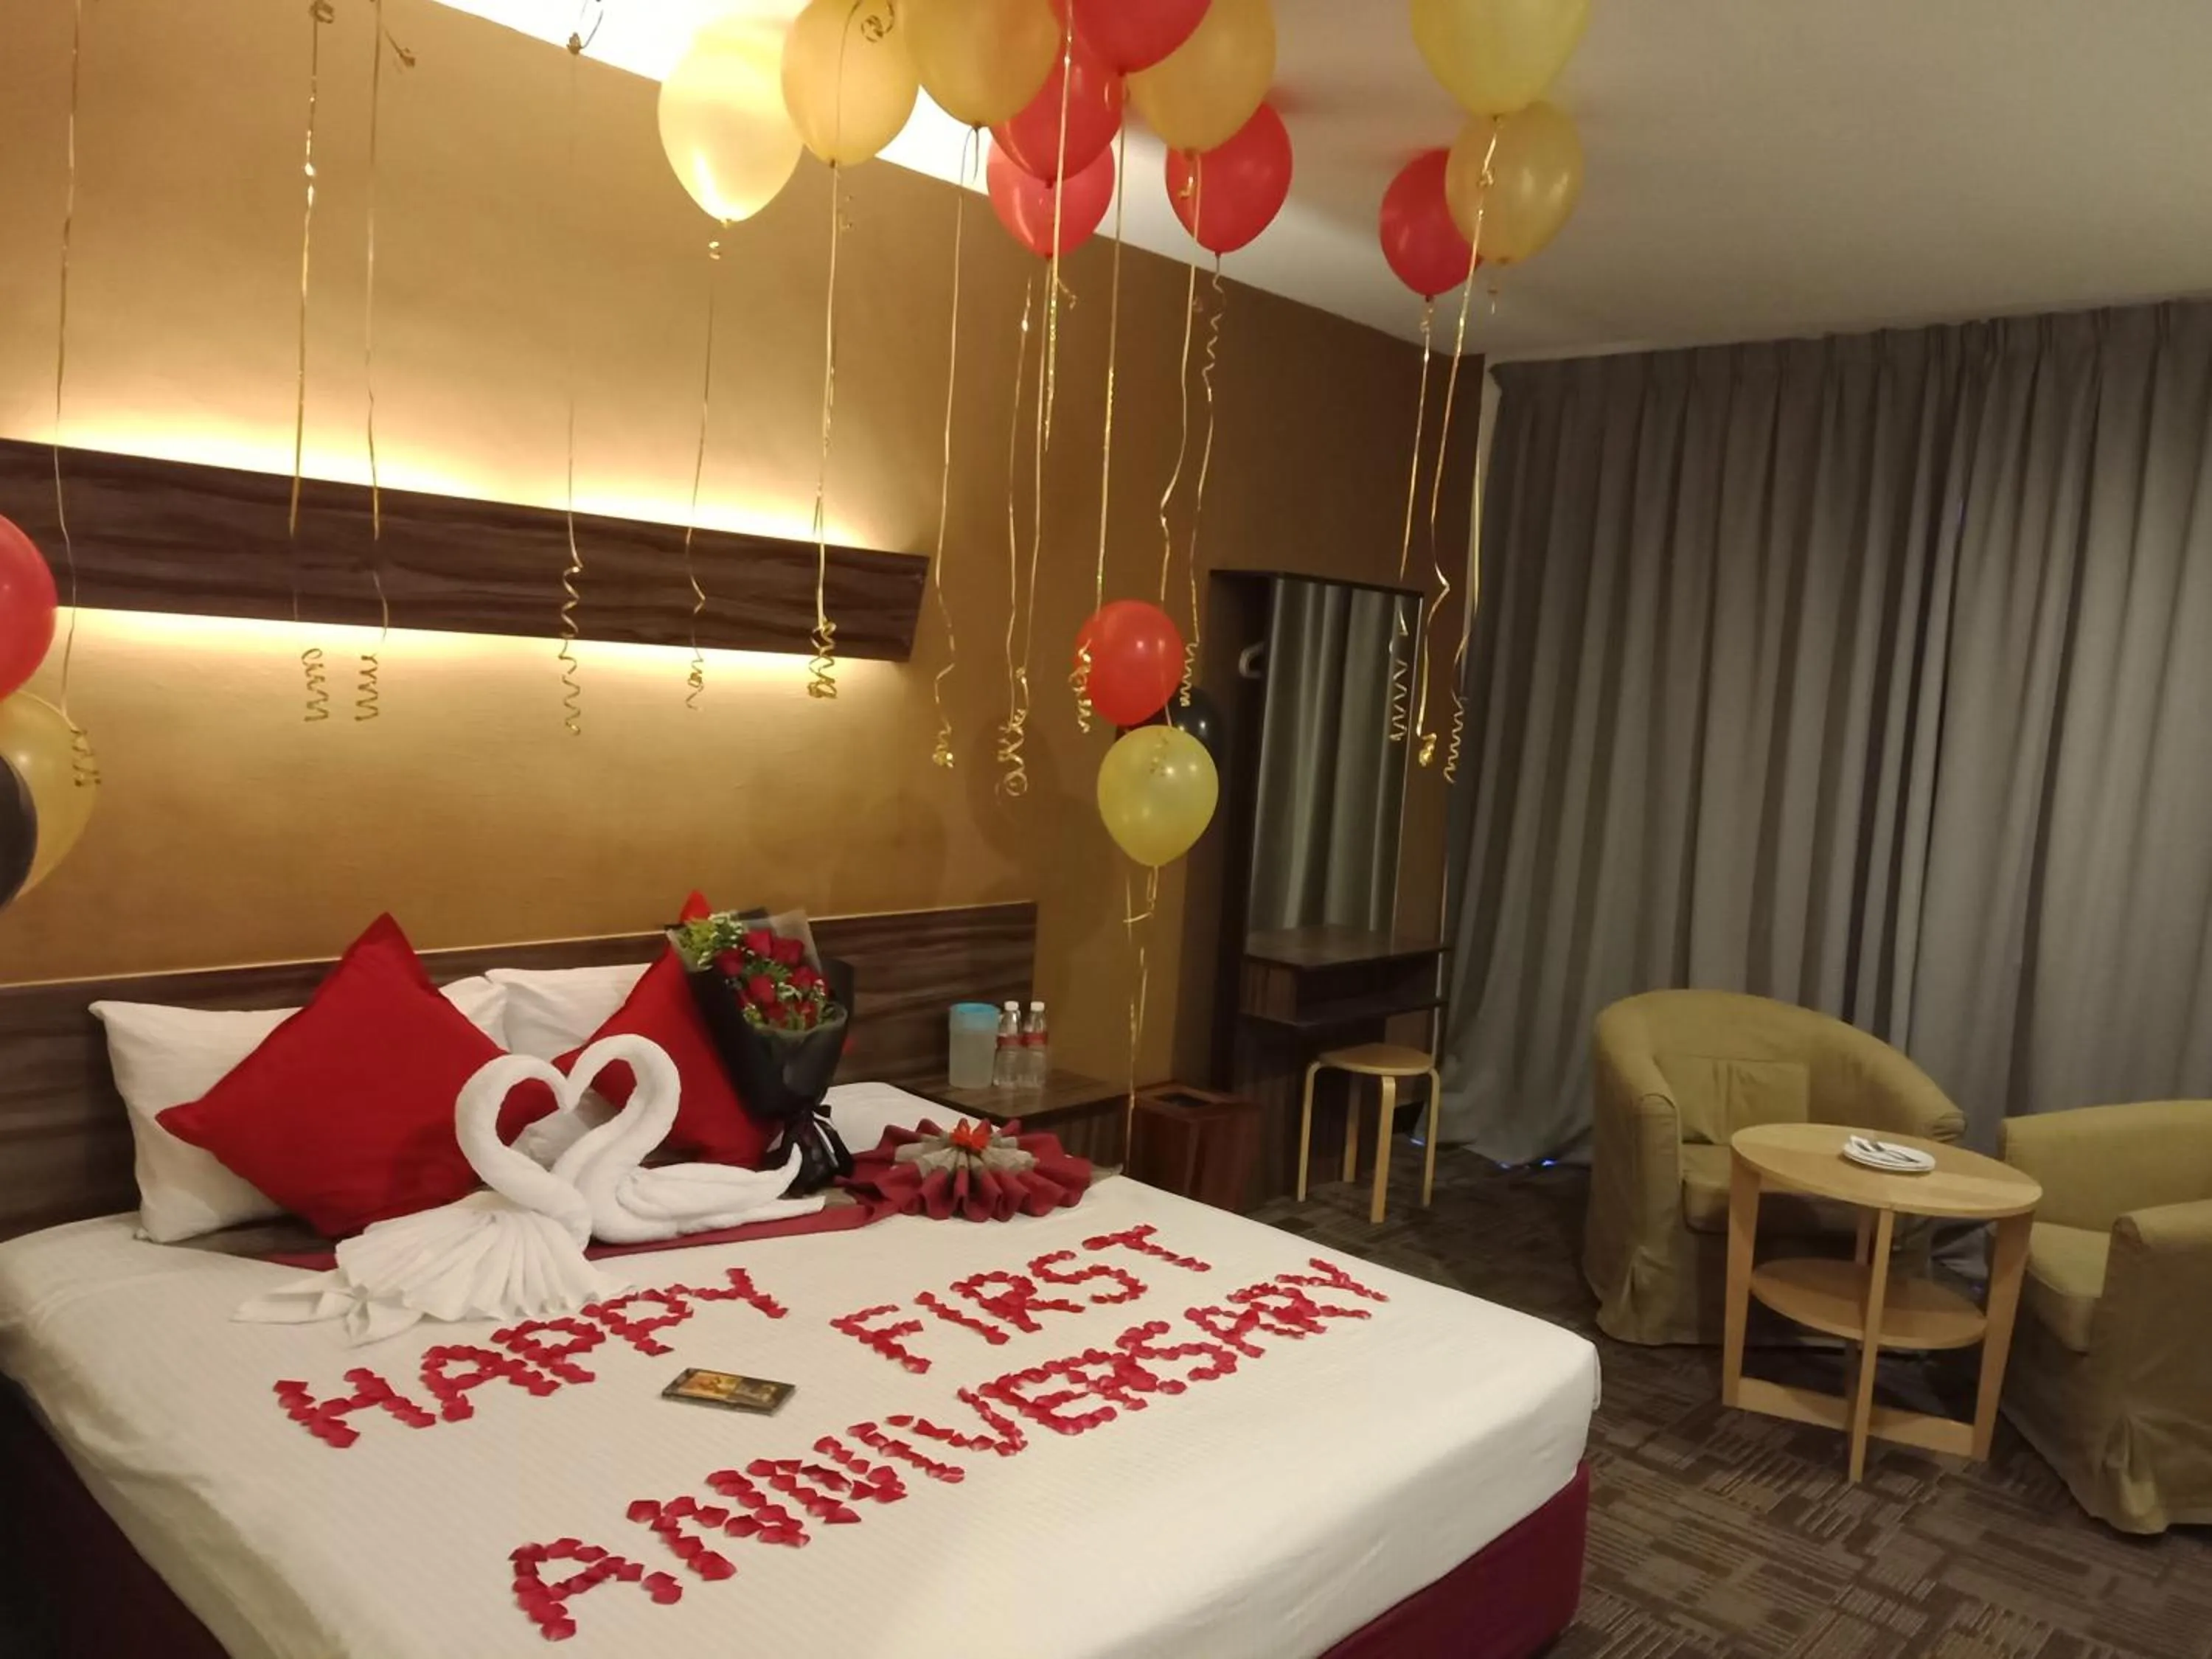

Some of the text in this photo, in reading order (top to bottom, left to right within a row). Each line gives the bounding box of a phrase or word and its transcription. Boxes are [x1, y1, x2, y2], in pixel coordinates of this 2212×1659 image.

[274, 1224, 1211, 1448] HAPPY FIRST
[509, 1258, 1389, 1641] ANNIVERSARY
